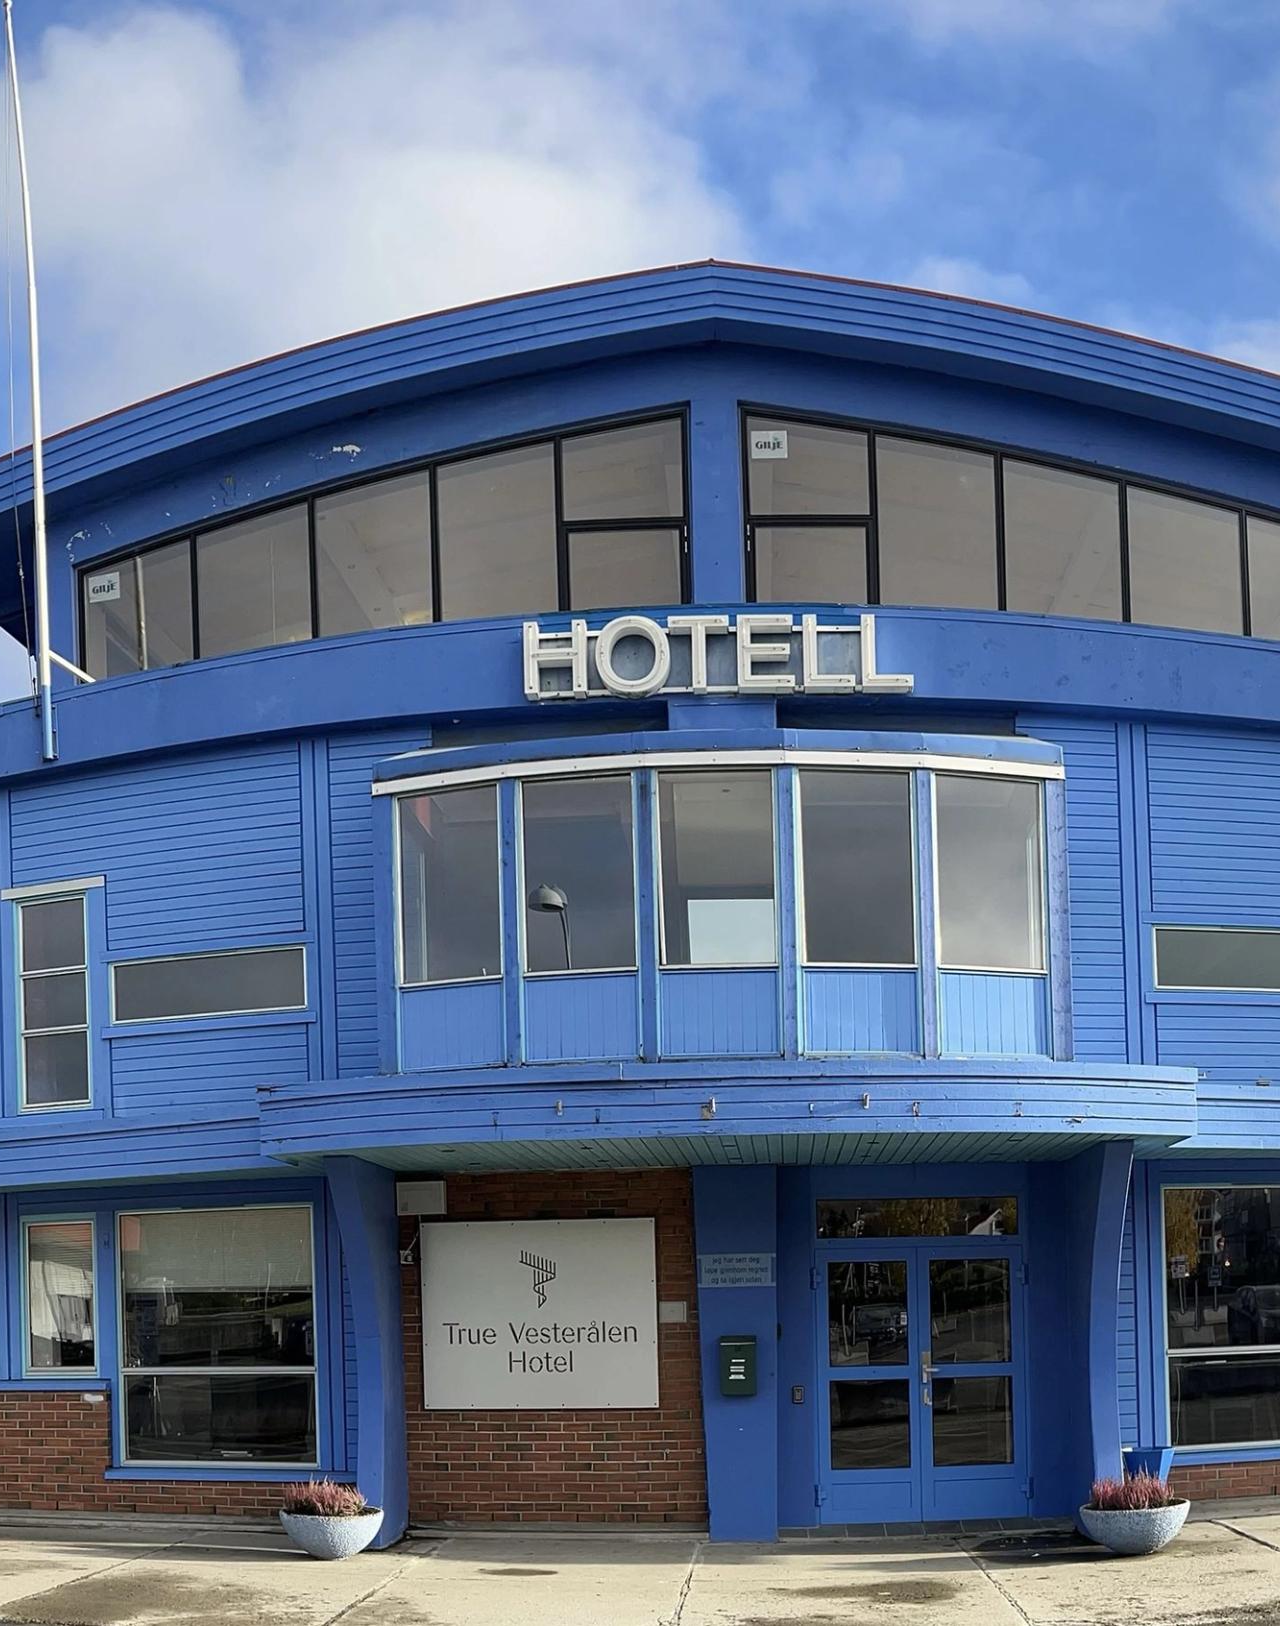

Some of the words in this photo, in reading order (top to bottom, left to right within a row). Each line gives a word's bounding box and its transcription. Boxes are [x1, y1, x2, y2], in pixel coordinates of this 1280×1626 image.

[523, 614, 914, 699] HOTELL
[442, 1322, 497, 1345] True
[508, 1320, 638, 1344] Vesterålen
[508, 1350, 574, 1373] Hotel
